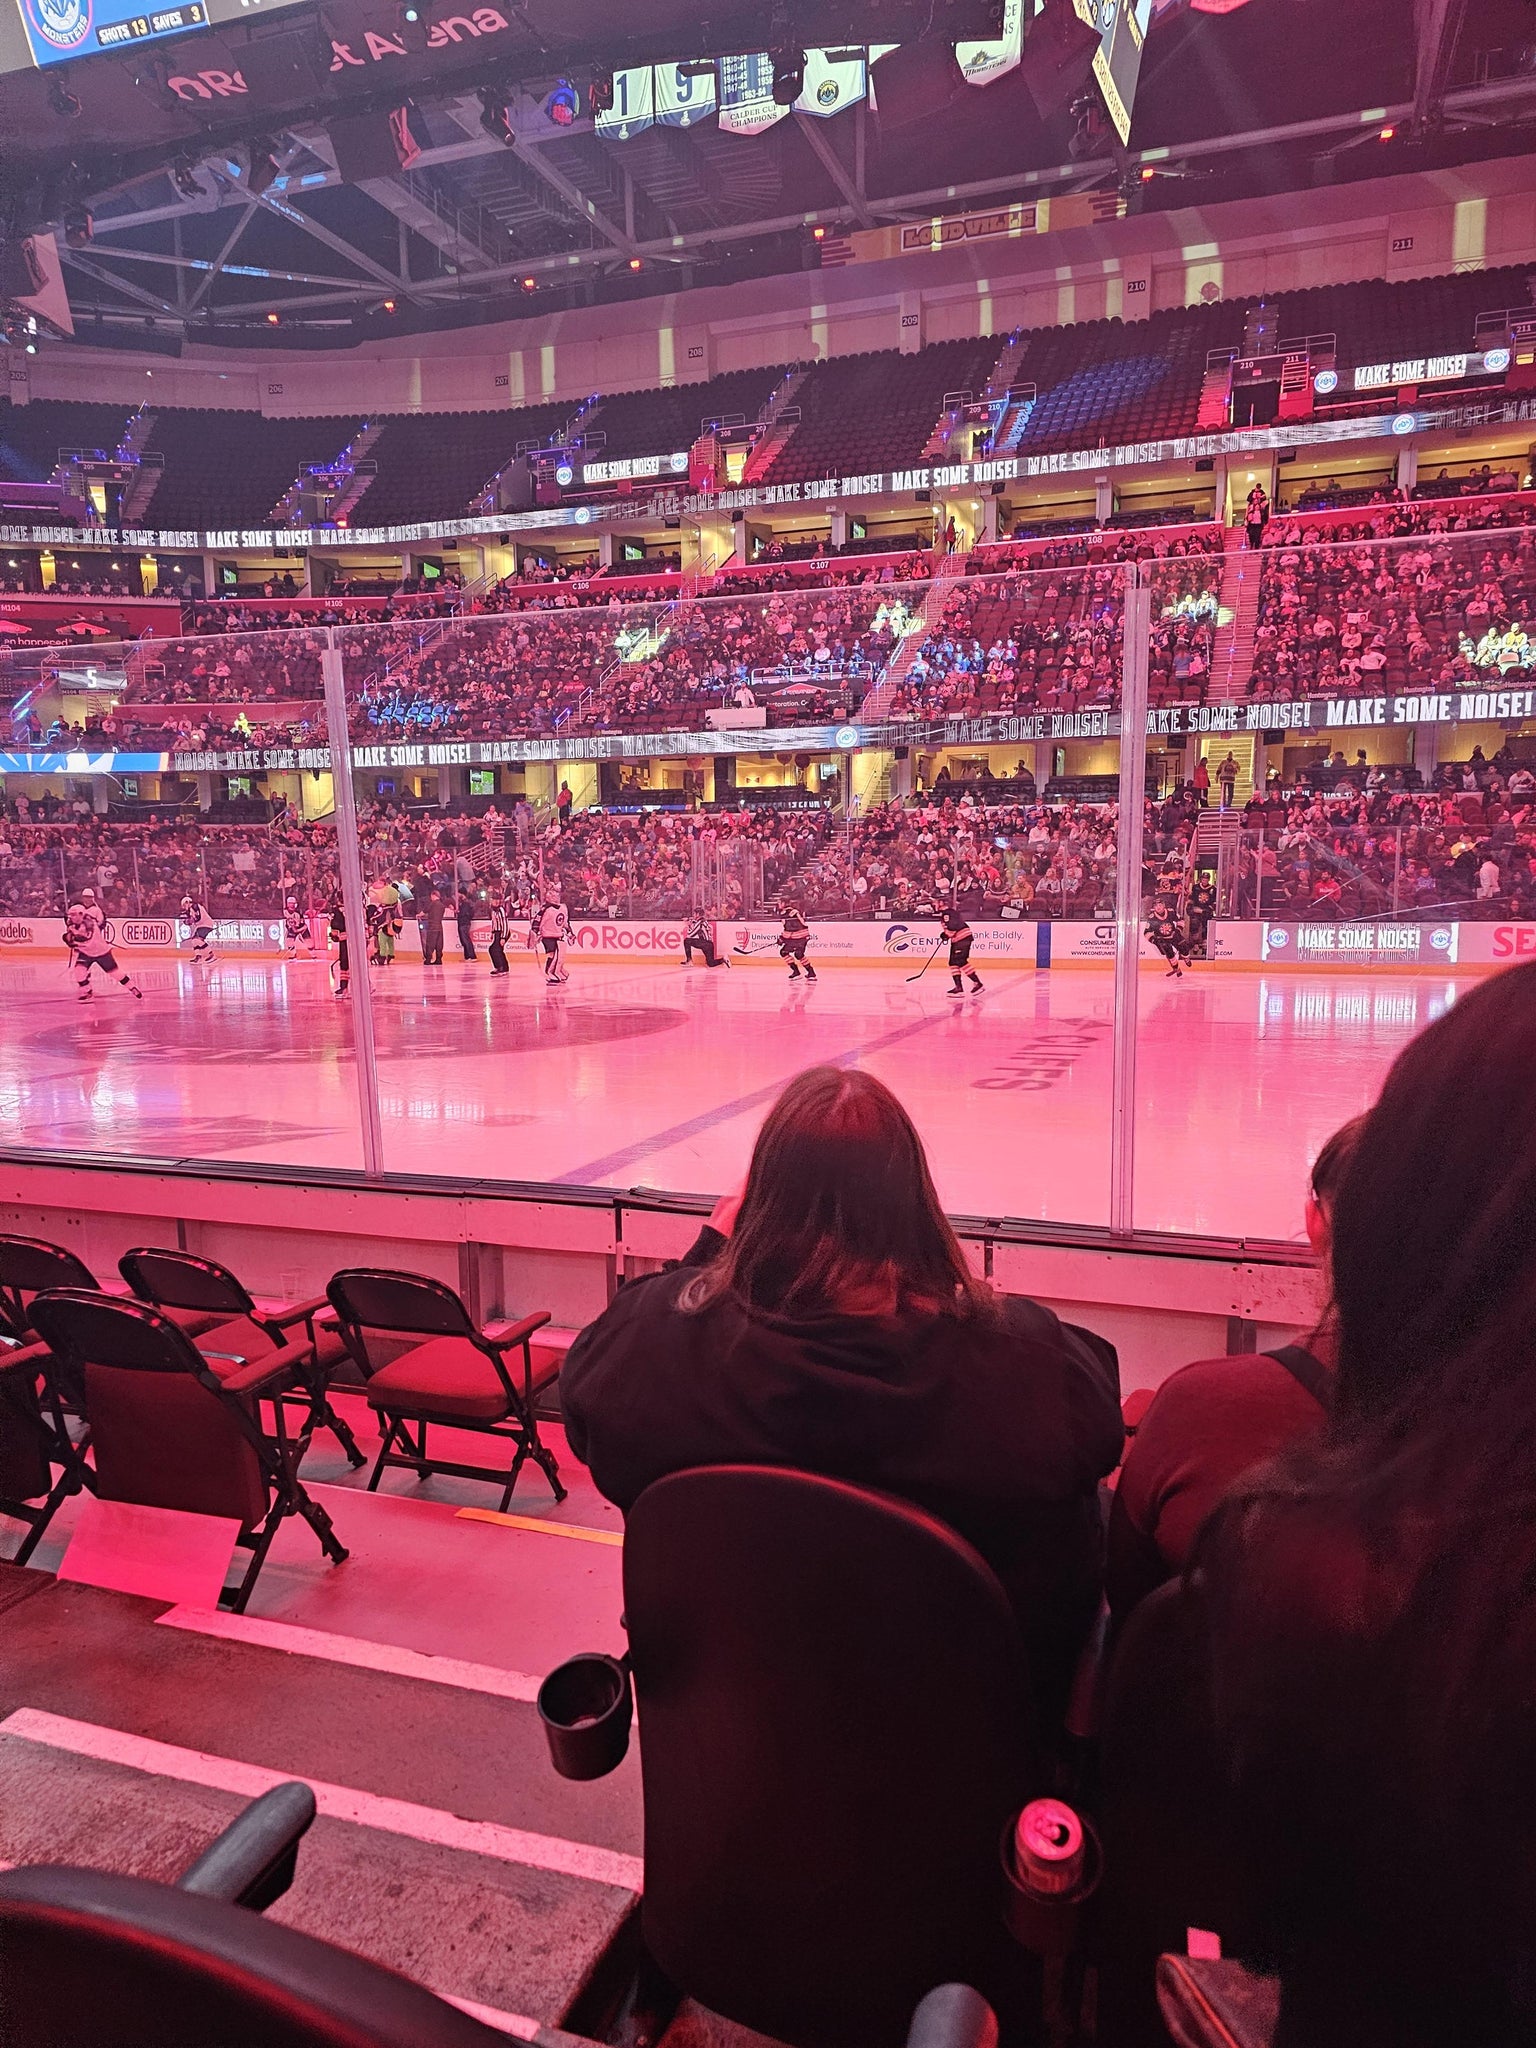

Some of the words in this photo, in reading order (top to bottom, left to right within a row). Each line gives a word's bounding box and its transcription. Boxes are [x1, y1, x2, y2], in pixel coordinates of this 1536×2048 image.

[41, 15, 89, 45] MONSTERS
[98, 29, 131, 46] SHOTS
[131, 19, 149, 37] 13
[151, 11, 182, 32] SAVES
[190, 5, 202, 22] 3
[617, 73, 628, 116] 1
[730, 109, 760, 120] CALDER
[731, 111, 778, 128] CHAMPIONS
[903, 207, 1037, 250] LOUDVILLE
[1394, 240, 1411, 249] 211
[1129, 281, 1144, 292] 210
[903, 316, 917, 326] 209
[1516, 325, 1532, 333] 211
[690, 348, 702, 357] 208
[11, 372, 26, 380] 205
[1355, 363, 1390, 387] MAKE
[1392, 358, 1426, 382] SOME
[1427, 354, 1467, 377] NOISE!
[496, 376, 508, 385] 207
[269, 385, 283, 394] 206
[988, 403, 1000, 411] 210
[584, 462, 609, 480] MAKE
[608, 459, 631, 478] SOME
[632, 456, 659, 476] NOISE!
[0, 525, 28, 541] OME
[33, 526, 73, 544] NOISE!
[83, 529, 119, 545] MAKE
[122, 530, 155, 546] SOME
[158, 531, 199, 547] NOISE!
[206, 531, 239, 547] MAKE
[242, 530, 272, 547] SOME
[276, 529, 313, 546] NOISE!
[320, 529, 352, 545] MAKE
[355, 527, 385, 544] SOME
[388, 523, 421, 543] NOISE!
[648, 497, 679, 516] MAKE
[683, 493, 714, 513] SOME
[718, 490, 757, 509] NOISE!
[765, 483, 800, 503] MAKE
[804, 479, 839, 500] SOME
[841, 474, 883, 497] NOISE!
[892, 469, 929, 491] MAKE
[933, 465, 969, 487] SOME
[973, 460, 1018, 482] NOISE!
[1027, 454, 1067, 476] MAKE
[1072, 448, 1110, 471] SOME
[1115, 441, 1162, 466] NOISE!
[1173, 434, 1218, 459] MAKE
[1082, 535, 1103, 544] 108
[174, 752, 218, 771] NOISE!
[226, 751, 260, 770] MAKE
[263, 749, 295, 769] SOME
[353, 746, 387, 767] MAKE
[390, 745, 424, 766] SOME
[428, 743, 471, 765] NOISE!
[480, 741, 518, 763] MAKE
[523, 739, 561, 760] SOME
[565, 737, 611, 758] NOISE!
[622, 735, 664, 757] MAKE
[878, 721, 931, 746] NOISE!
[944, 718, 992, 743] MAKE
[999, 715, 1045, 741] SOME
[1052, 711, 1109, 739] NOISE!
[1146, 709, 1181, 734] AKE
[1188, 706, 1238, 732] SOME
[1245, 702, 1312, 730] NOISE!
[1326, 698, 1387, 726] MAKE
[1393, 695, 1452, 723] SOME
[1459, 691, 1533, 720] NOISE!
[0, 922, 27, 938] odelo
[219, 925, 239, 940] SOME
[240, 924, 264, 940] NOISE!
[973, 930, 989, 940] ank
[992, 930, 1025, 940] Boldly.
[1298, 929, 1336, 949] MAKE
[1338, 929, 1375, 949] SOME
[1377, 929, 1421, 949] NOISE!
[829, 941, 854, 949] Institute
[988, 941, 1013, 950] Fully.
